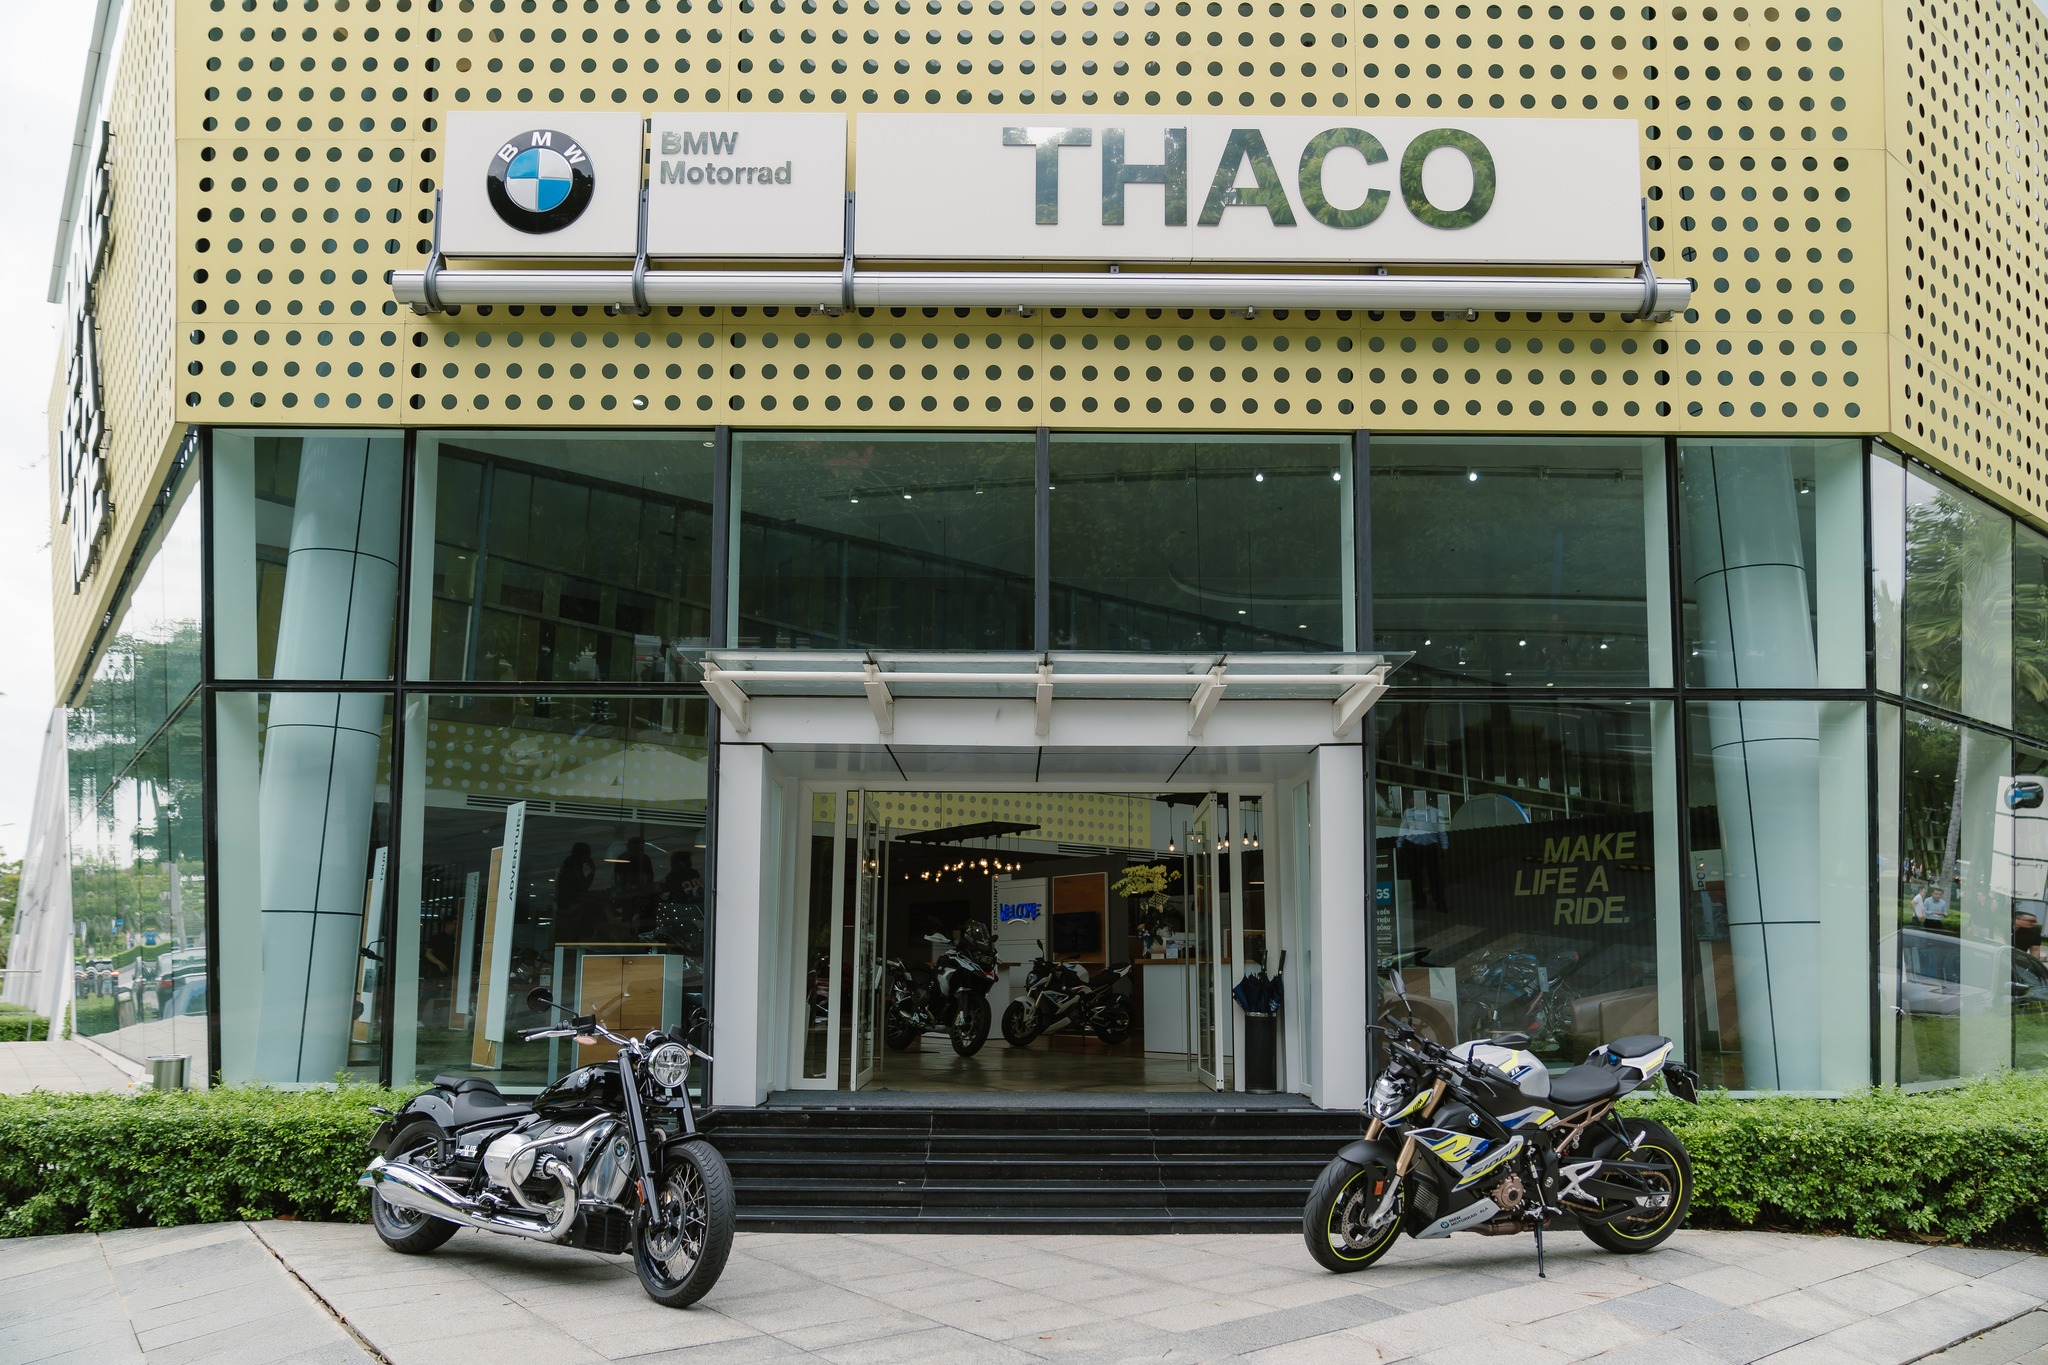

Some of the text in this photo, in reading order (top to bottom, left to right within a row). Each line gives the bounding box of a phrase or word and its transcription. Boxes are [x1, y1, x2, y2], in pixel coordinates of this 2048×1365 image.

[497, 131, 586, 164] BMW
[661, 131, 739, 155] BMW
[660, 160, 792, 185] Motorrad
[1002, 127, 1497, 230] THACO
[508, 807, 523, 902] ADVENTURE
[1543, 831, 1637, 864] MAKE
[1514, 865, 1609, 896] LIFE A
[999, 902, 1041, 921] WELCOME
[1553, 896, 1630, 925] RIDE.
[1448, 1215, 1461, 1223] BMW
[1450, 1212, 1478, 1226] MOTORRAD
